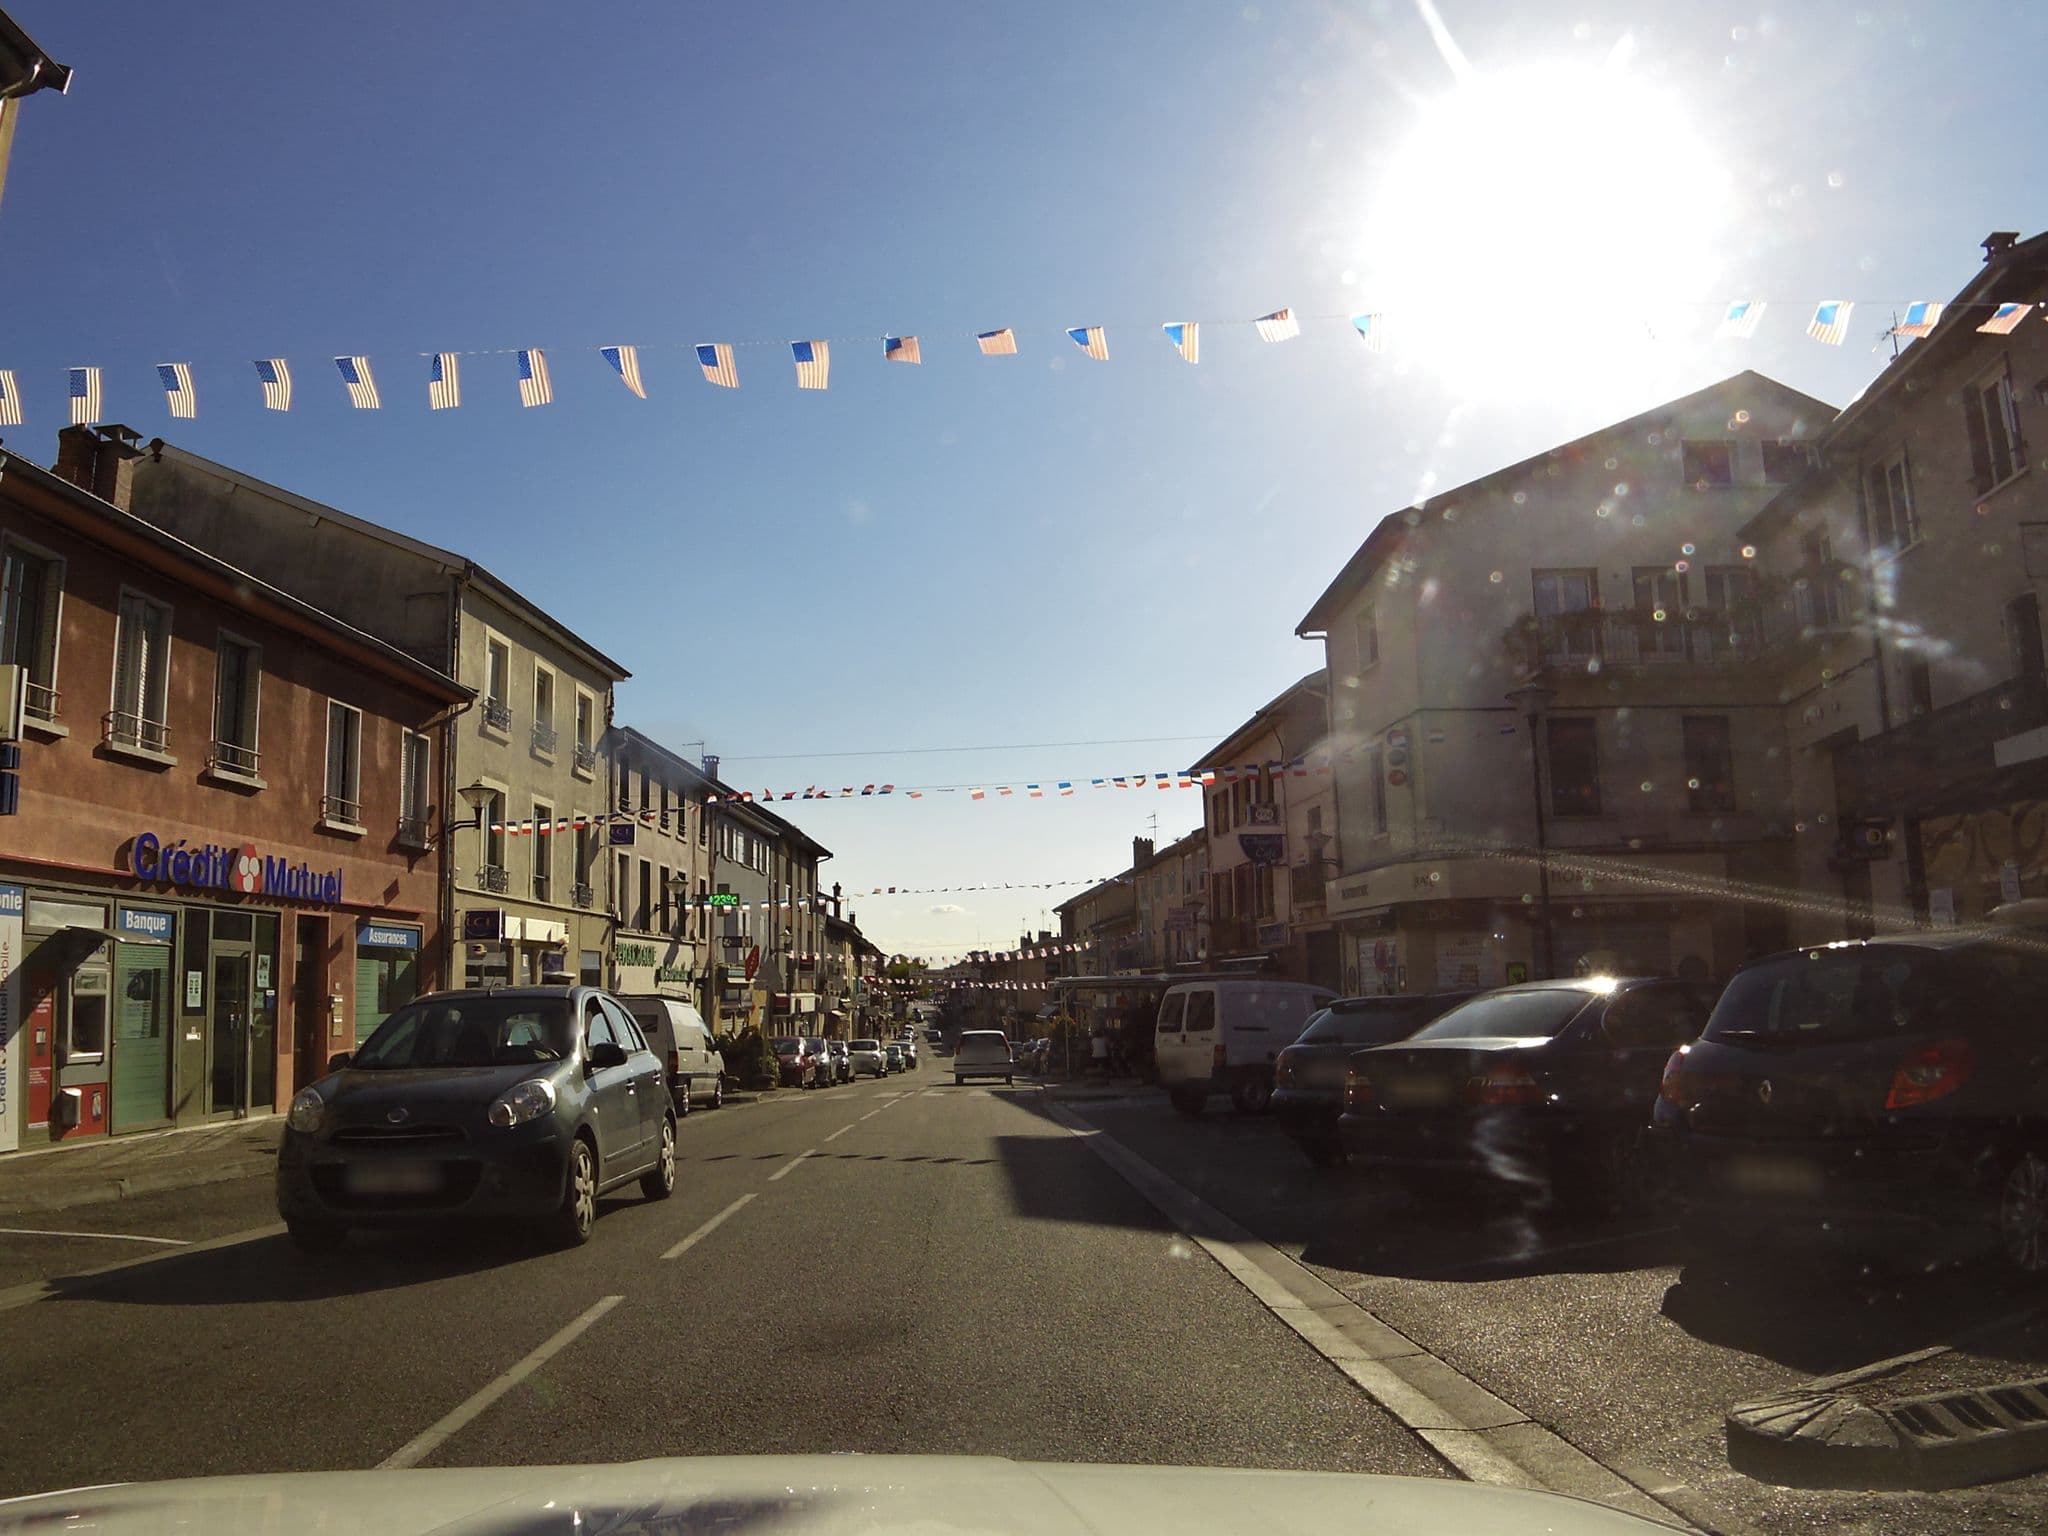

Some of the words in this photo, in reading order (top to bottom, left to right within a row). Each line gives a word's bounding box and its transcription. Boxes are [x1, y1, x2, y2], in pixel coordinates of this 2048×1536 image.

[133, 832, 230, 889] Crédit
[265, 855, 343, 904] Mutuel
[126, 909, 166, 933] Banque
[368, 927, 408, 946] Assurances
